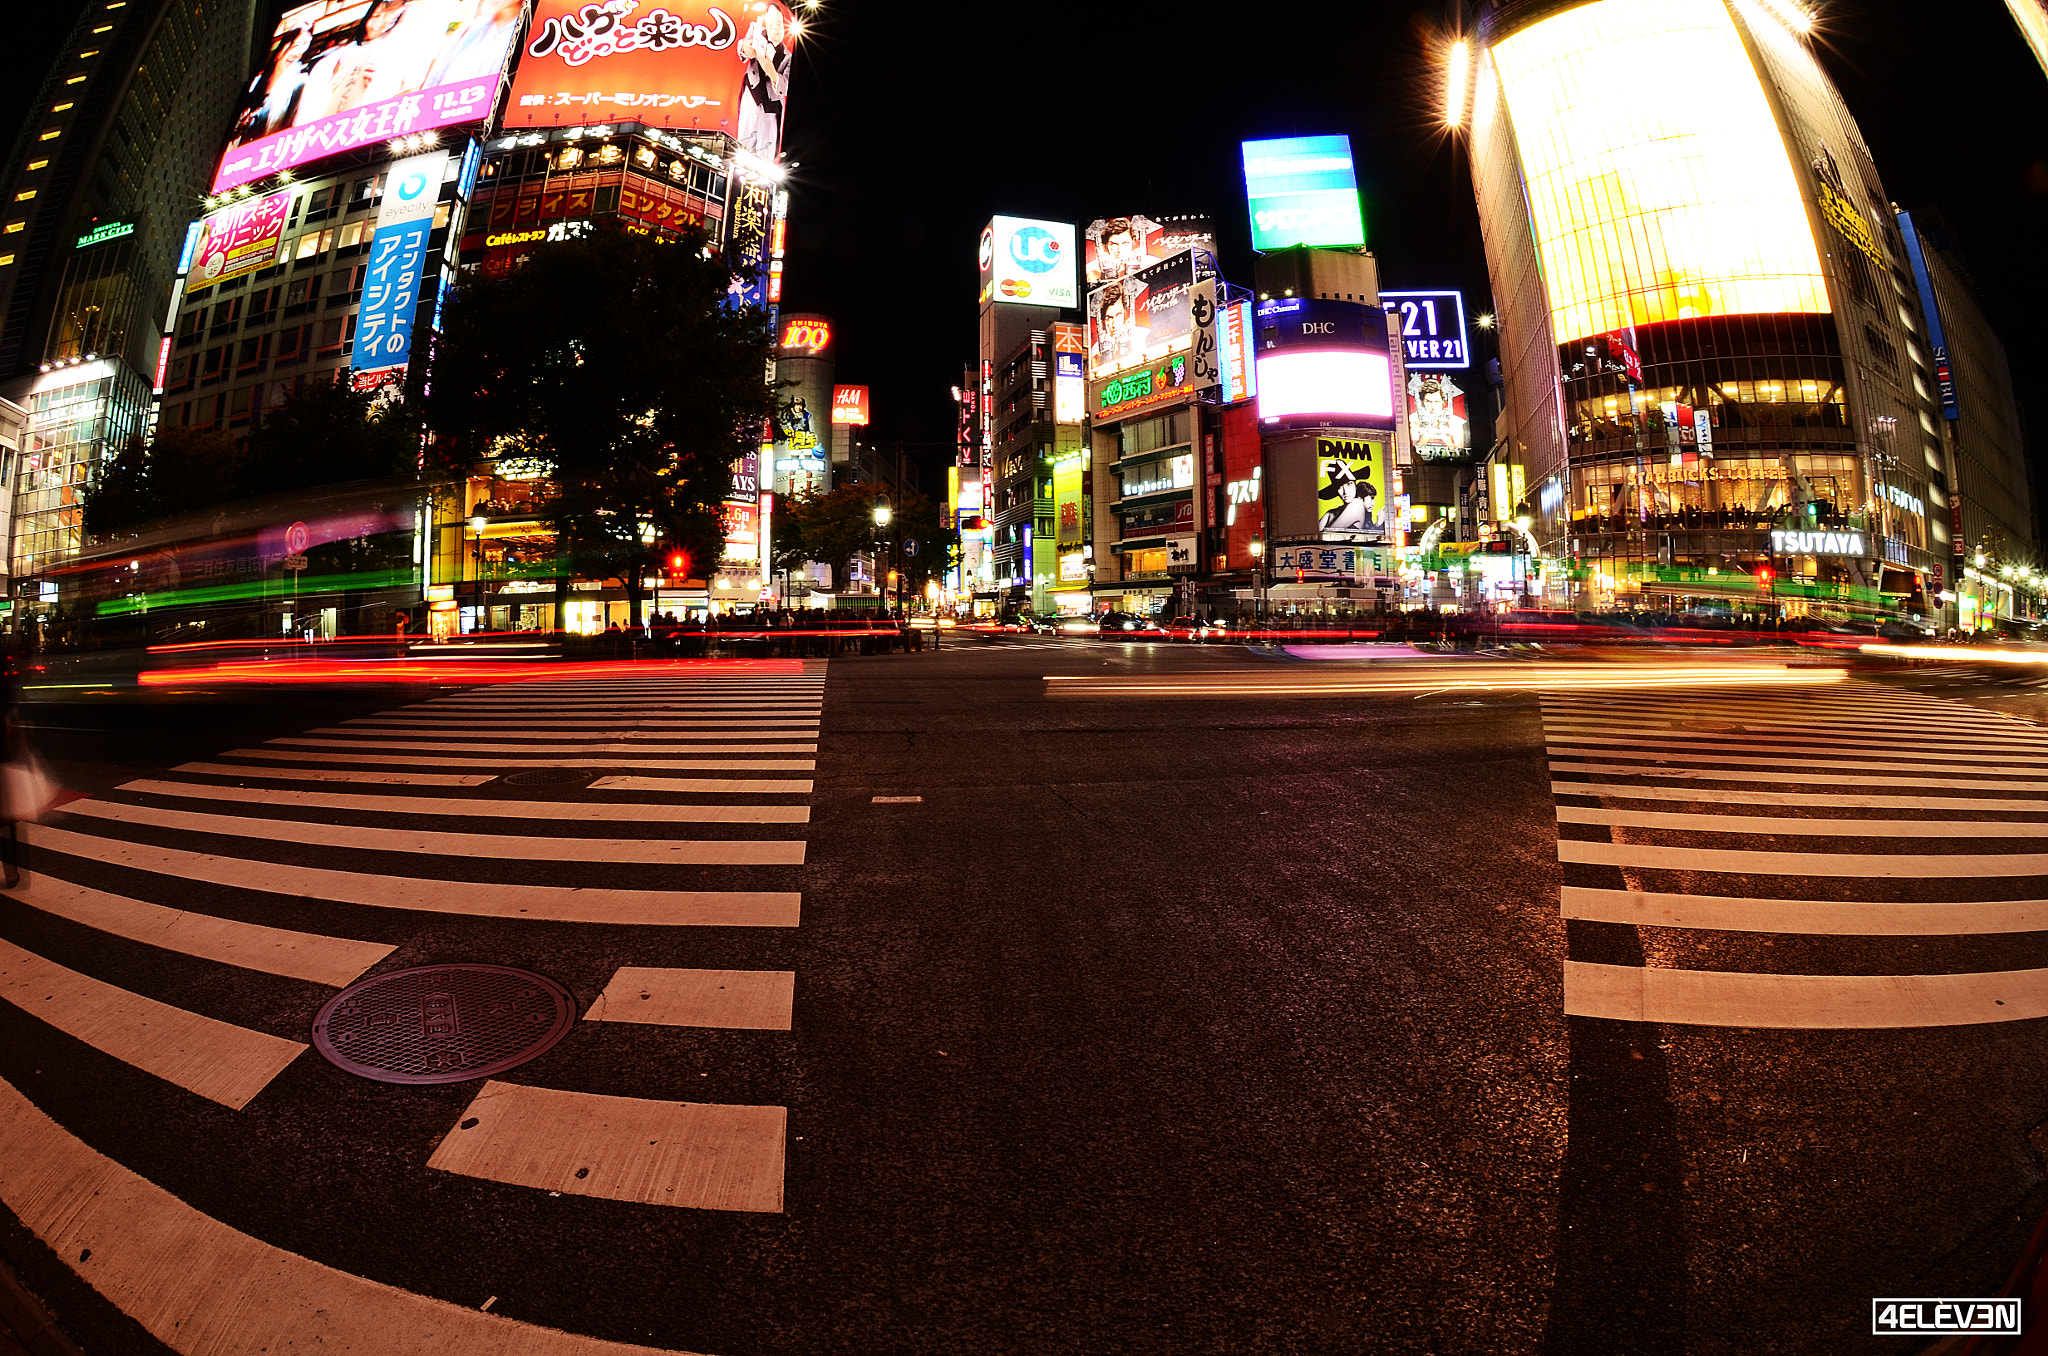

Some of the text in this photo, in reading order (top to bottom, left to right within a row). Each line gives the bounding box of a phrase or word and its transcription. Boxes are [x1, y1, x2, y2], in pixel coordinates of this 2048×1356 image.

[433, 85, 486, 110] 11.13
[251, 94, 423, 172] エリザベス女王杯
[385, 200, 430, 217] eyecity
[77, 223, 135, 246] MARK CITY
[207, 217, 283, 257] クリニック
[362, 235, 403, 357] アイシティ
[386, 231, 422, 354] コンタクトの
[1048, 288, 1072, 297] VISA
[1257, 308, 1272, 316] DHC
[791, 320, 829, 329] SHIBUYA
[1302, 322, 1335, 335] DHC
[780, 325, 829, 353] 109
[1191, 293, 1219, 382] もんじゃ
[1442, 339, 1462, 359] 21
[1933, 347, 1955, 405] SEIBU
[836, 388, 862, 405] H&M
[1394, 383, 1404, 425] neon
[1318, 440, 1373, 461] DMM
[1319, 460, 1356, 481] FX
[1627, 465, 1788, 486] STARBUCKS COFFEE
[1124, 478, 1172, 496] Euphoria
[1061, 501, 1077, 526] 薬
[1177, 503, 1192, 519] JTB
[1771, 532, 1864, 555] TSUTAYA
